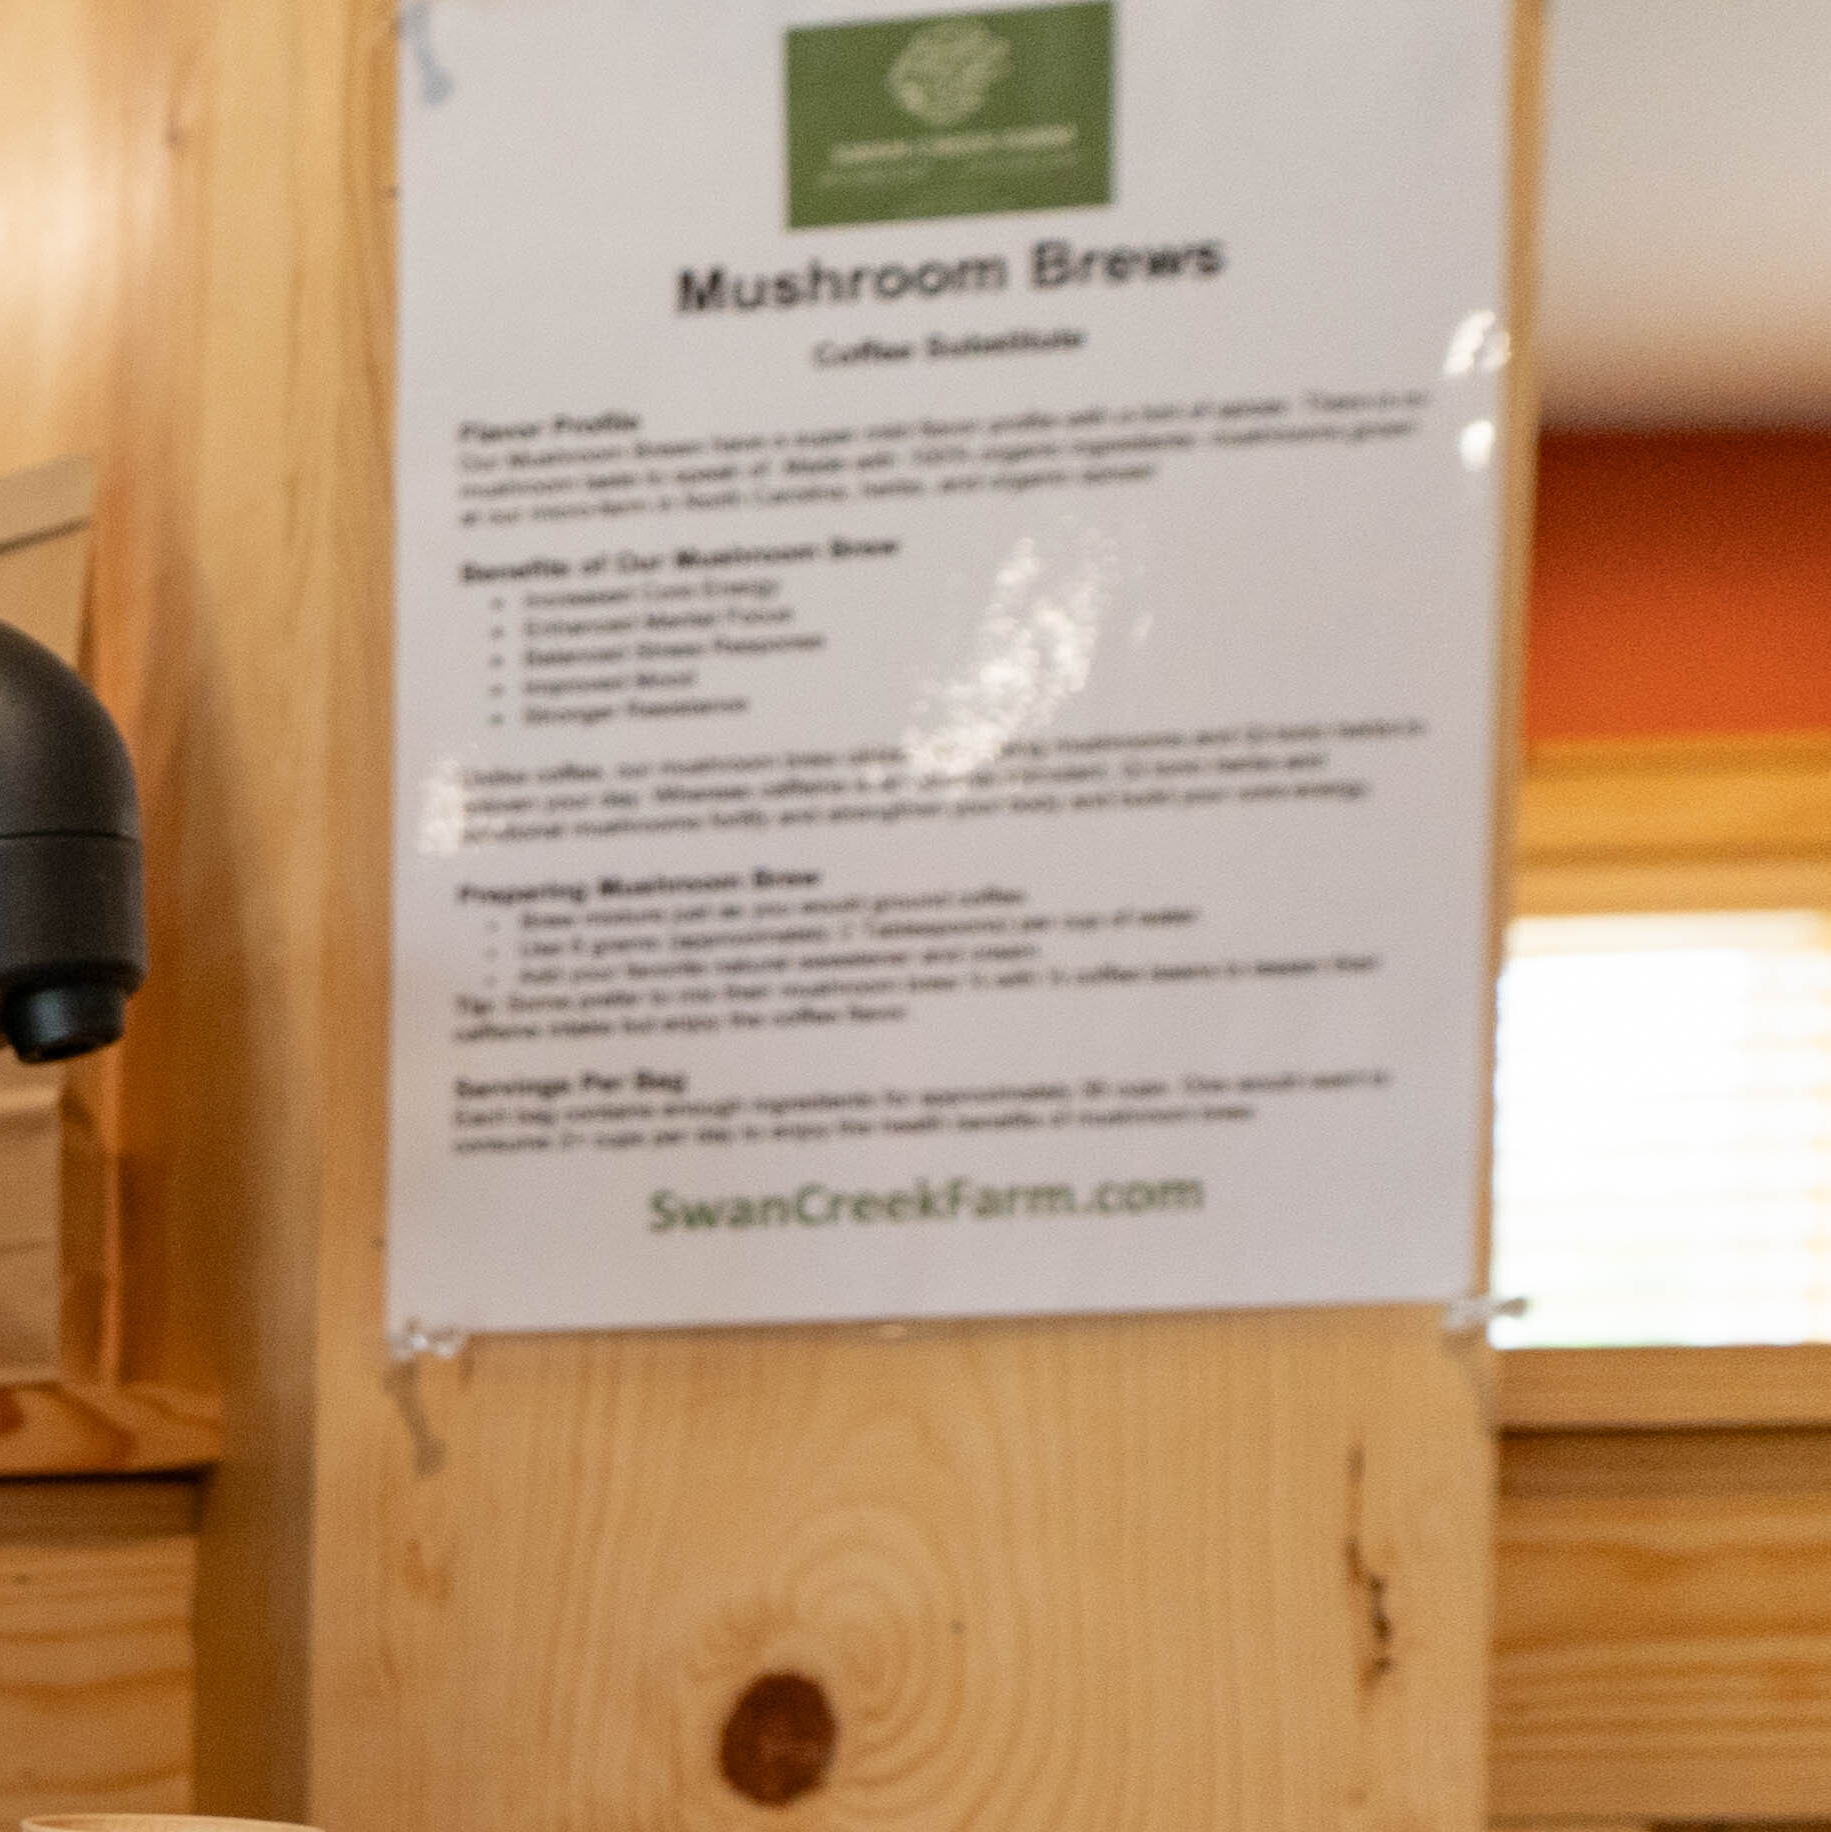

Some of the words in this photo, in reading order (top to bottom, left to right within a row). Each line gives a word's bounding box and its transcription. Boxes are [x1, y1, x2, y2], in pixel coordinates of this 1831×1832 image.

[675, 254, 1010, 314] Mushroom
[1031, 238, 1227, 289] Brews
[648, 1175, 1205, 1234] SwanCreekFarm.com
